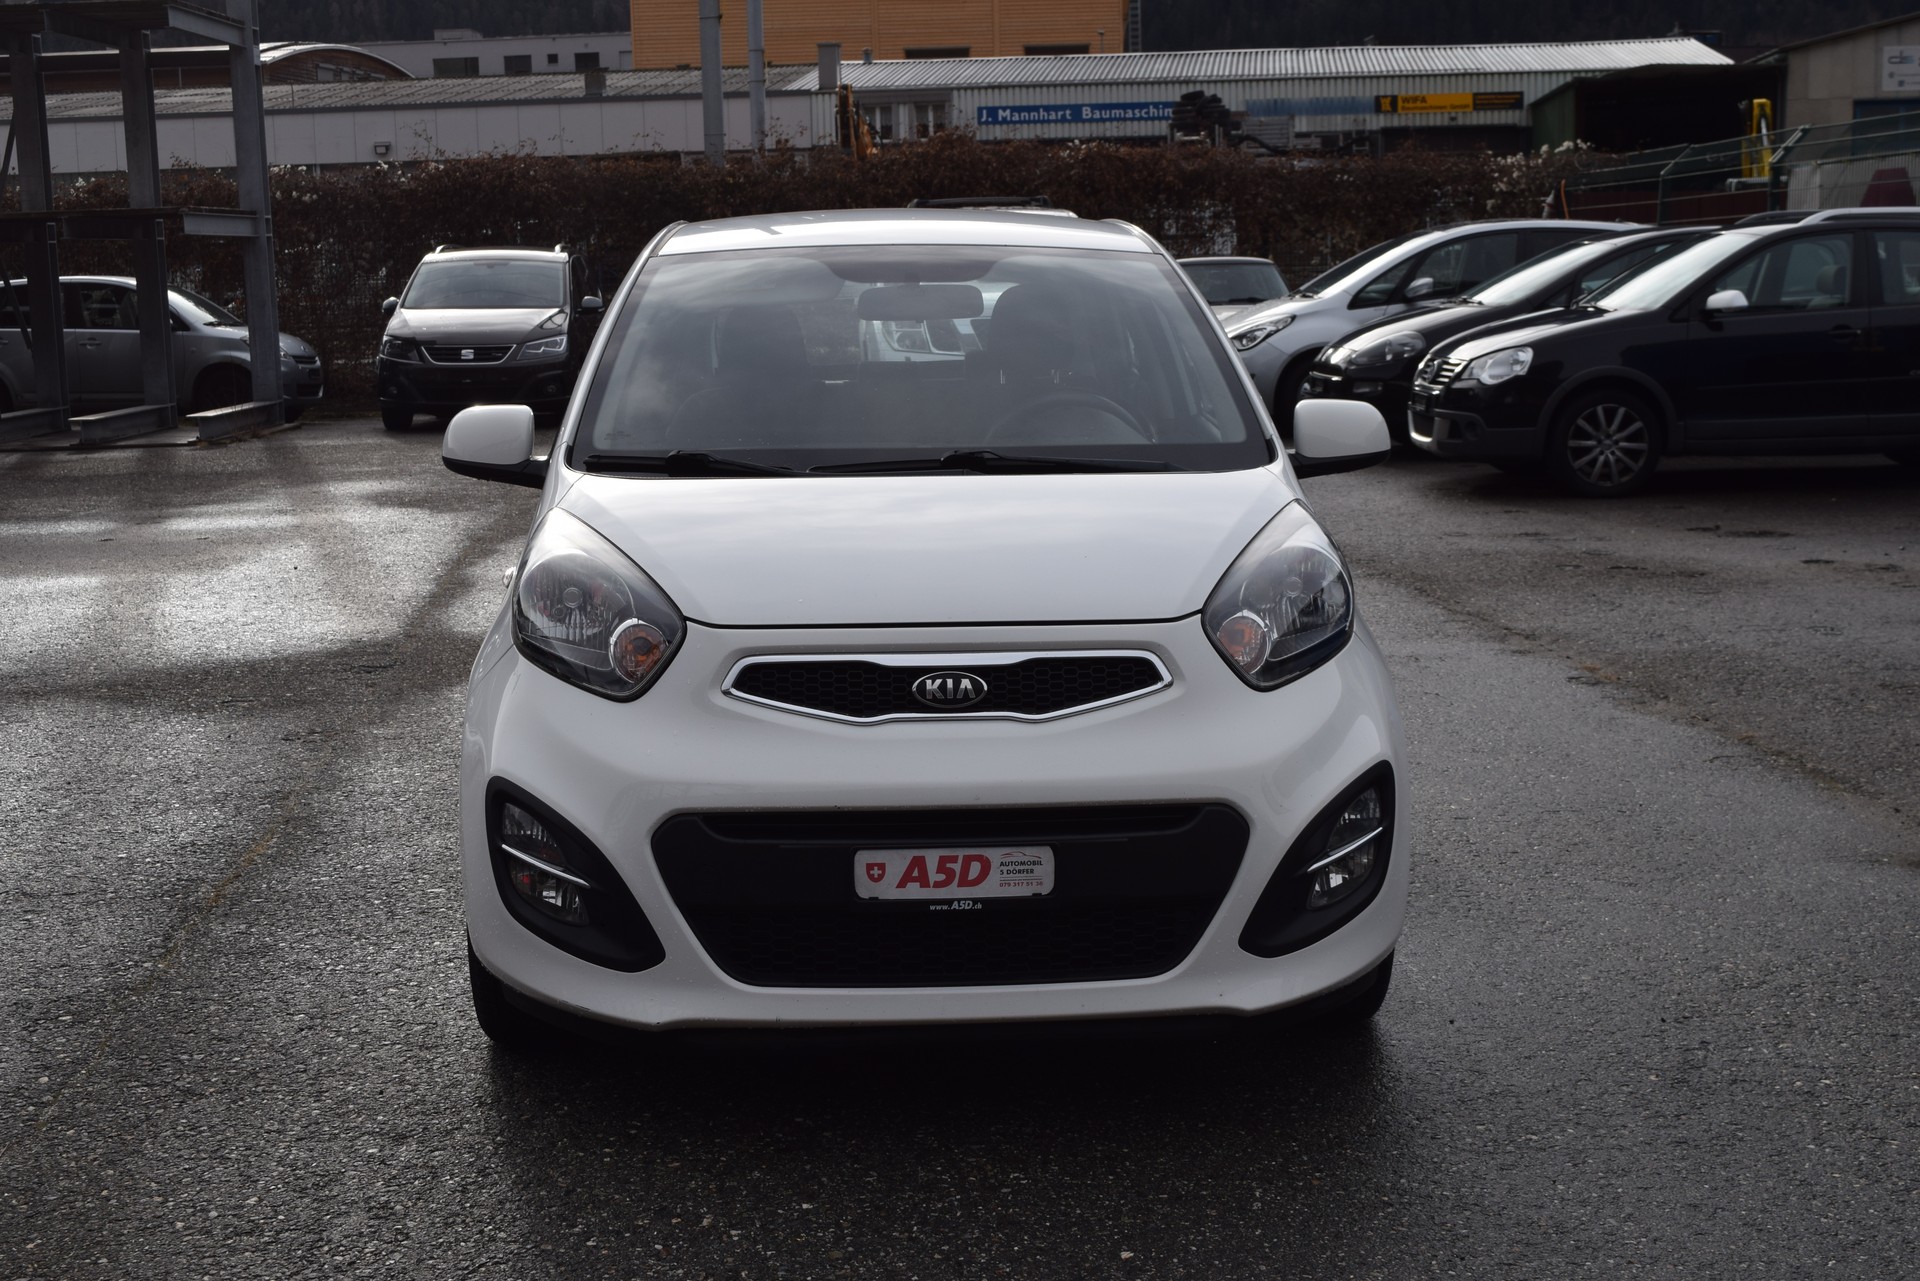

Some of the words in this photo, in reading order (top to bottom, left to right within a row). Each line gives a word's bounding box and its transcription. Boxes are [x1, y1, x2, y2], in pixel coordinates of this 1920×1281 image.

[1401, 95, 1428, 104] WIFA
[980, 109, 992, 122] J.
[998, 108, 1072, 122] Mannhart
[925, 678, 976, 699] KIA
[895, 854, 992, 889] A5D
[1006, 867, 1035, 875] DÖRFER
